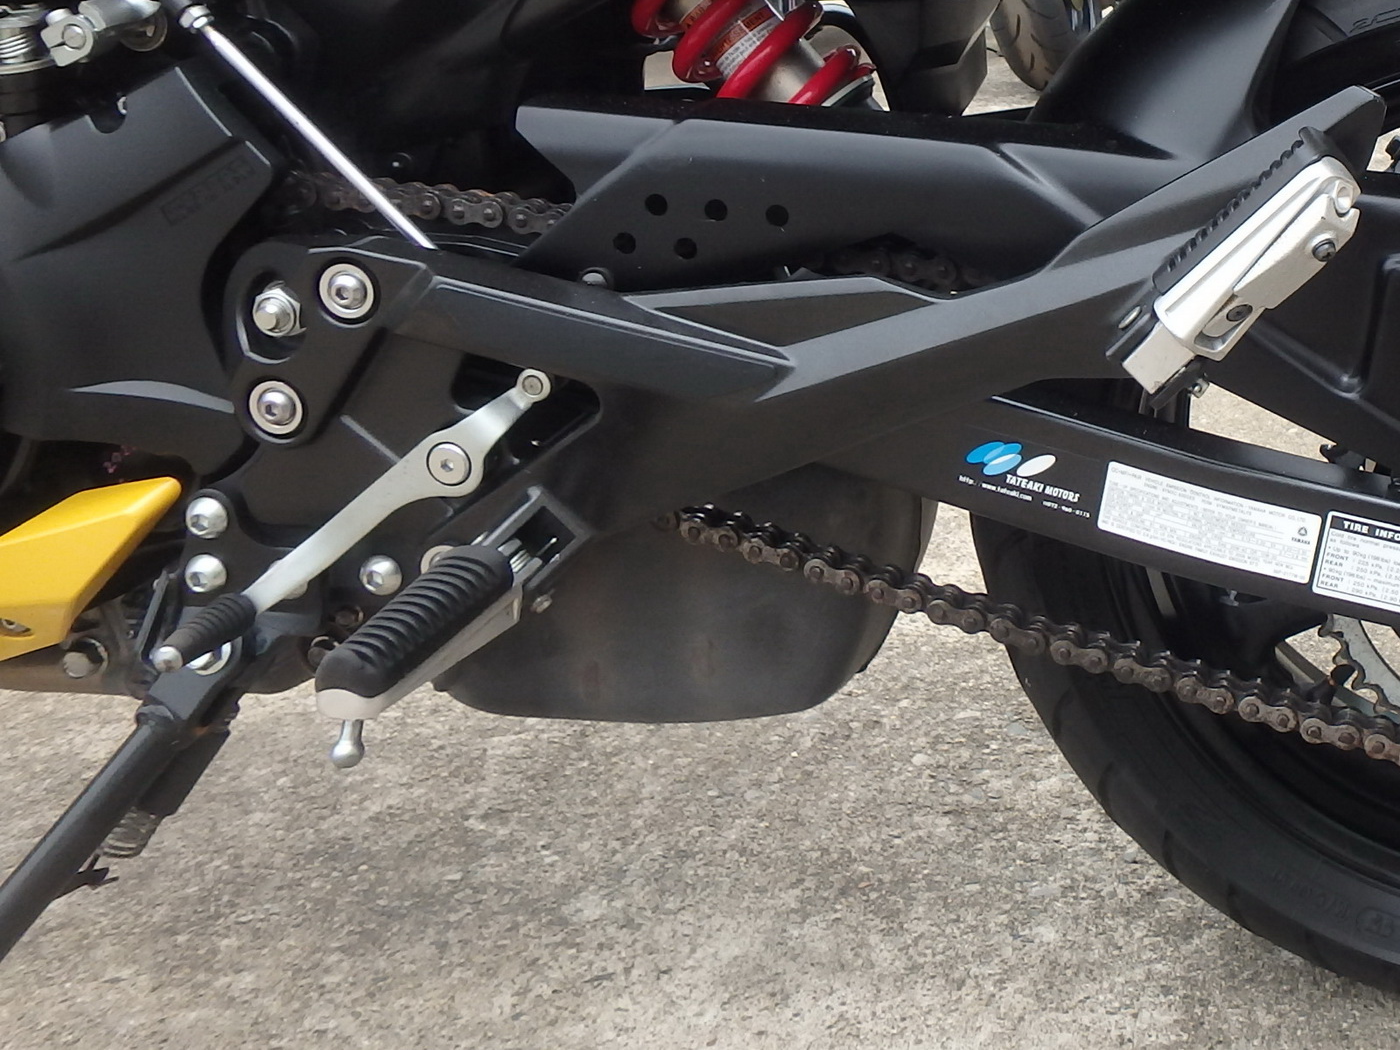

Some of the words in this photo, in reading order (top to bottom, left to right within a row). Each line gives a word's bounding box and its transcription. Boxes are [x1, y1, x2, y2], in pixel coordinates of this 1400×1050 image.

[1006, 474, 1044, 493] TATEAKI
[1044, 485, 1080, 503] MOTORS
[1342, 520, 1369, 534] TIRE
[1326, 552, 1348, 561] FRONT
[1325, 559, 1343, 568] REAR
[1321, 573, 1344, 583] FRONT
[1320, 580, 1339, 589] REAR
